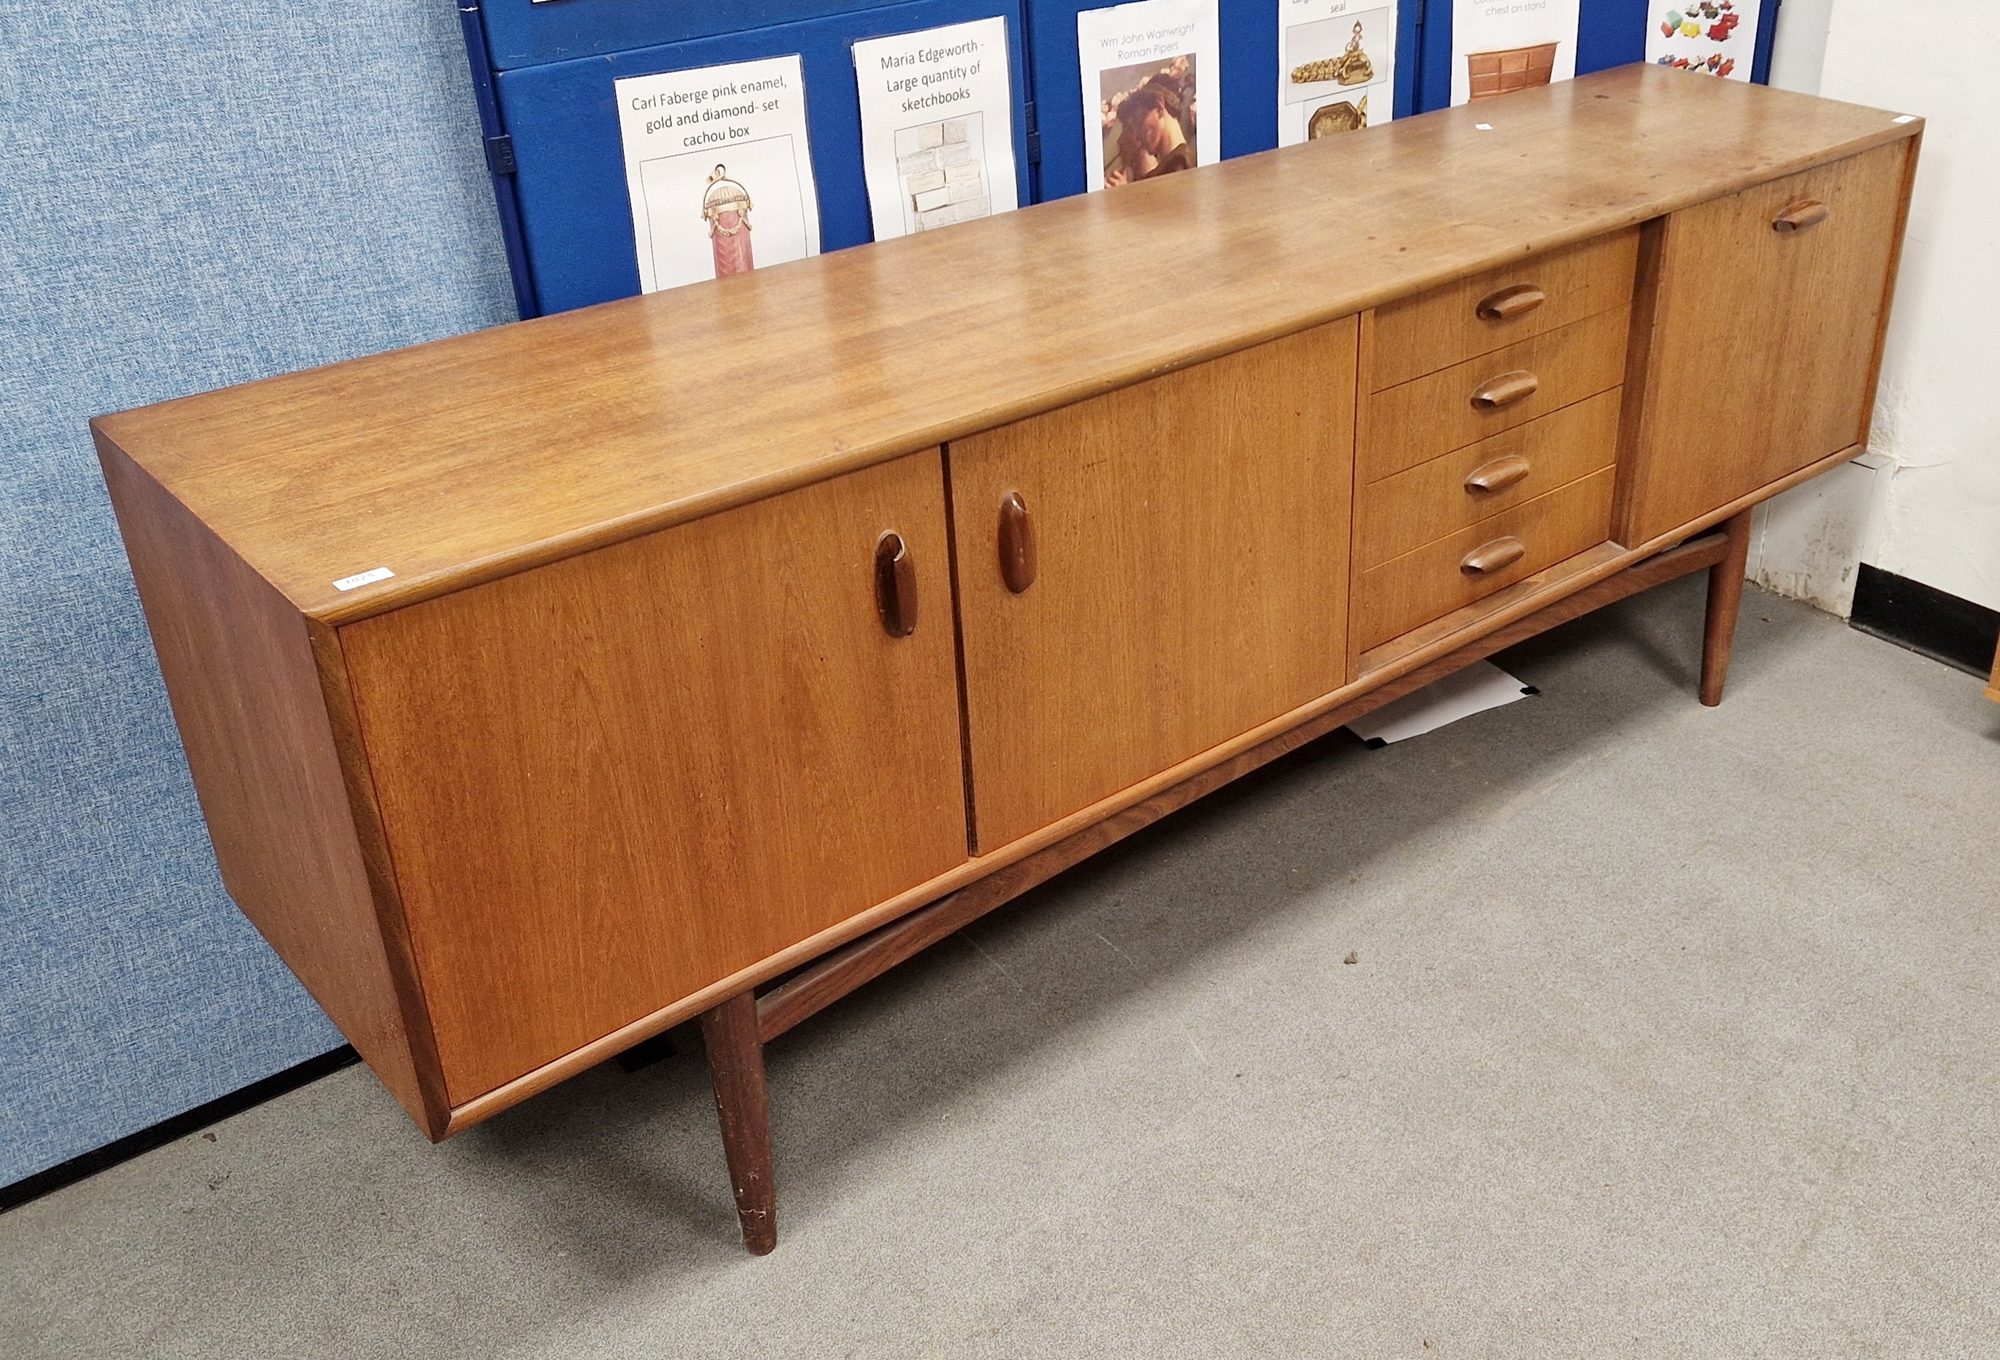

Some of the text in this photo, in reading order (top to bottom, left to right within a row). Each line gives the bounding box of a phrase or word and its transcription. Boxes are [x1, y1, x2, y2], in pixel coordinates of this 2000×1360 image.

[1330, 1, 1346, 13] seal
[1485, 0, 1546, 16] chest on stand
[1100, 23, 1195, 48] Wm John Wainwright
[881, 52, 915, 70] Maria
[918, 39, 978, 64] Edgeworth
[1118, 42, 1179, 60] Roman Pipers
[886, 60, 981, 92] Large quantity of
[631, 74, 787, 111] Carl Faberge pink enamel,
[901, 87, 971, 112] sketchbooks
[645, 99, 779, 135] gold and diamond- set
[683, 126, 750, 147] cachou box
